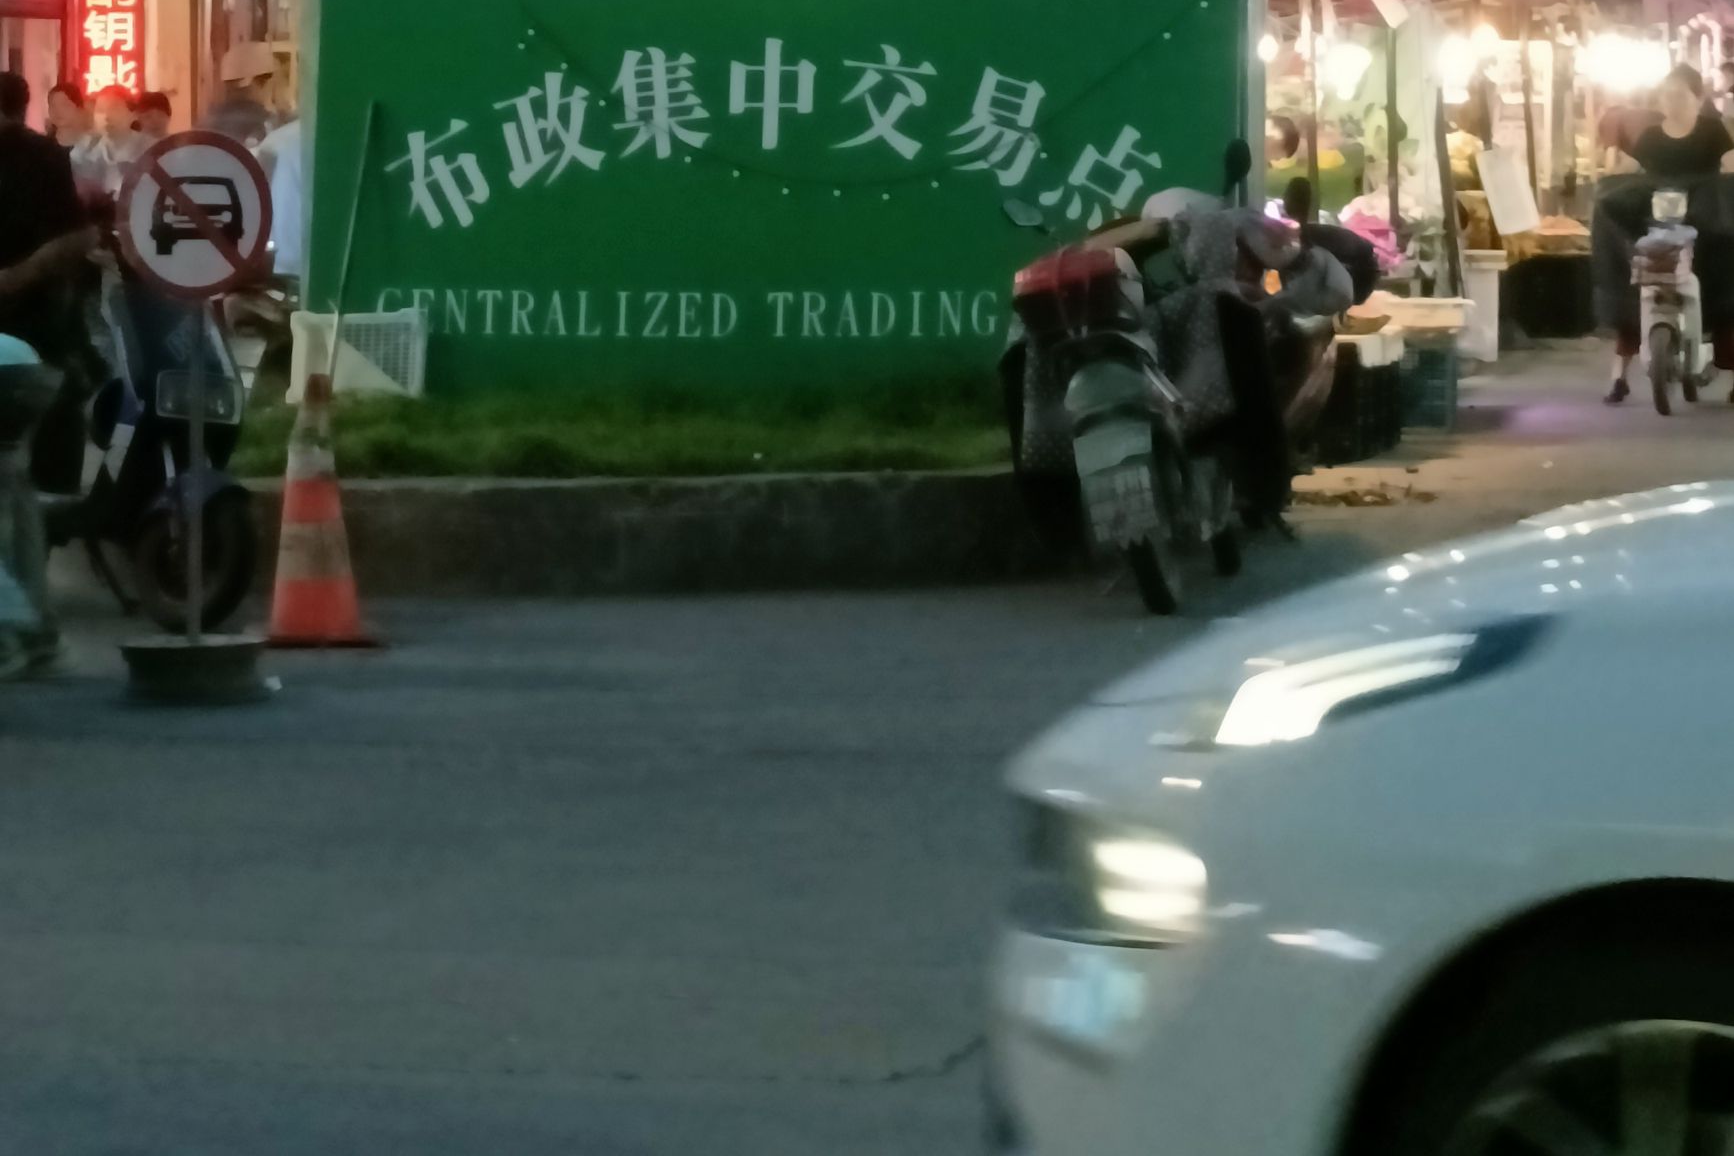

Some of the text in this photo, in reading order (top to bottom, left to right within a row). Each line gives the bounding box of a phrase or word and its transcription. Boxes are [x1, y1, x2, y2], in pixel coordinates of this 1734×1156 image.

[385, 38, 1162, 230] 布政集中交易点
[767, 290, 999, 338] TRADING
